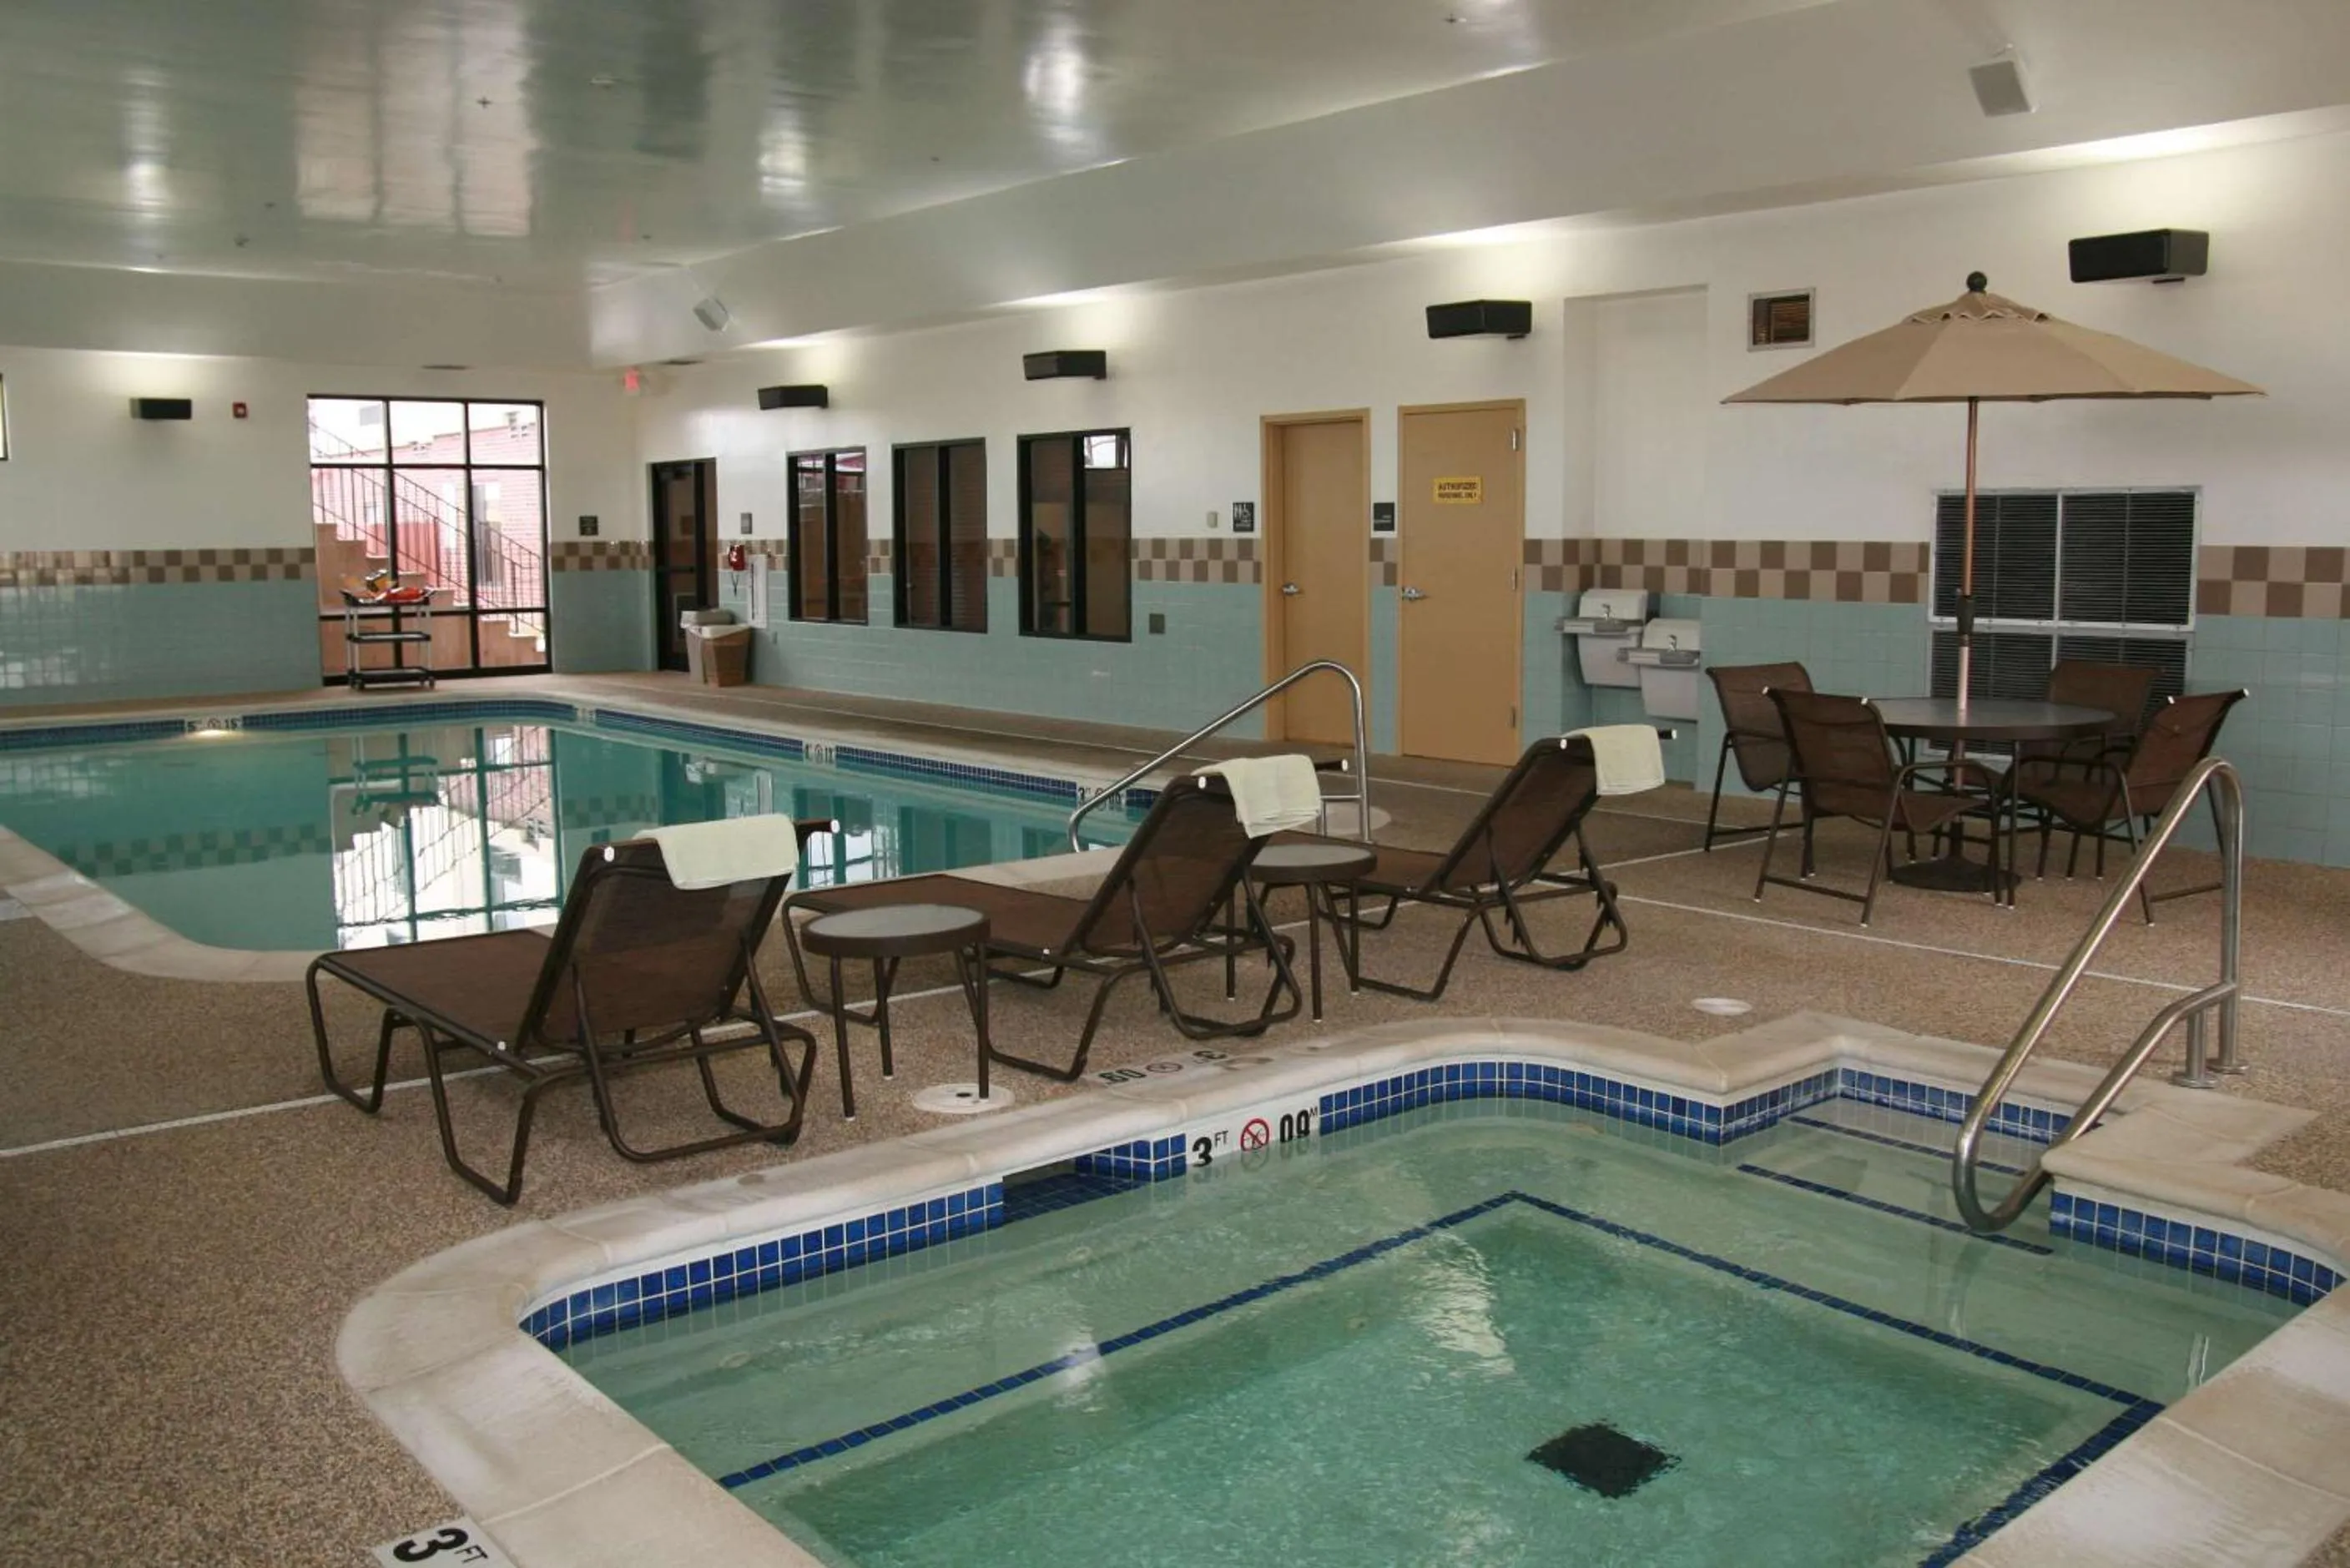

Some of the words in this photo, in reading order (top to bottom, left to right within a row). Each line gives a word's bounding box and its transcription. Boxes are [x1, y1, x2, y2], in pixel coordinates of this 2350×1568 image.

[1192, 1136, 1213, 1167] 3
[393, 1528, 469, 1562] 3
[454, 1544, 489, 1564] FT
